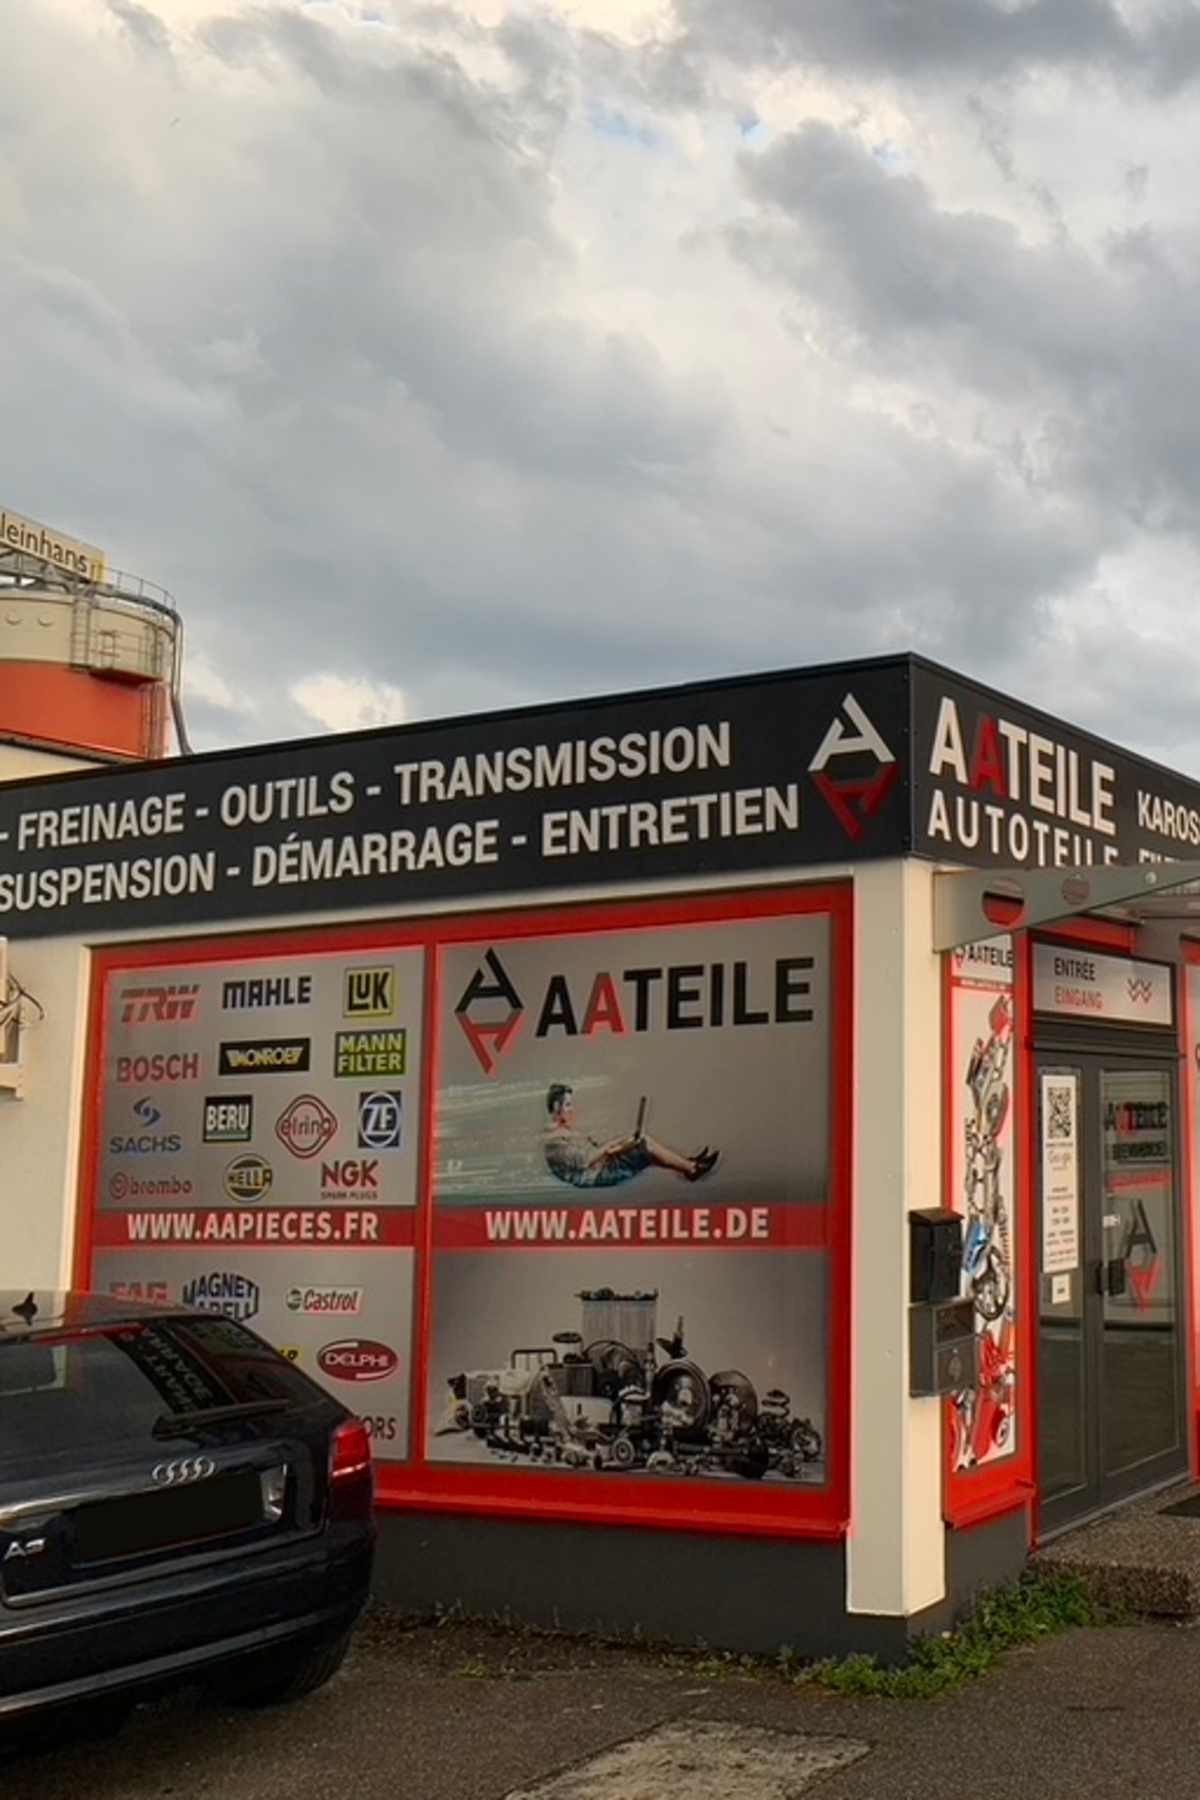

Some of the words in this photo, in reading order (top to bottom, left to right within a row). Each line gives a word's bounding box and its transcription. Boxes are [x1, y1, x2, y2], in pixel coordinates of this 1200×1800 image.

[928, 696, 1116, 836] AATEILE
[18, 793, 186, 851] FREINAGE
[221, 771, 355, 826] OUTILS
[394, 721, 731, 805] TRANSMISSION
[0, 851, 216, 912] SUSPENSION
[253, 819, 499, 888] DÉMARRAGE
[542, 784, 799, 857] ENTRETIEN
[1054, 956, 1096, 982] ENTRÉE
[222, 975, 313, 1010] MAHLE
[535, 957, 815, 1038] AATEILE
[339, 1033, 402, 1053] MANN
[116, 1052, 200, 1083] BOSCH
[337, 1052, 402, 1073] FILTER
[206, 1103, 250, 1132] BERU
[363, 1103, 398, 1136] ZF
[110, 1134, 182, 1154] SACHS
[321, 1160, 379, 1188] NGK
[127, 1210, 379, 1240] WWW.AAPIECES.FR
[485, 1207, 770, 1241] WWW.AATEILE.DE
[302, 1287, 359, 1312] Castrol
[325, 1351, 390, 1367] DELPHI
